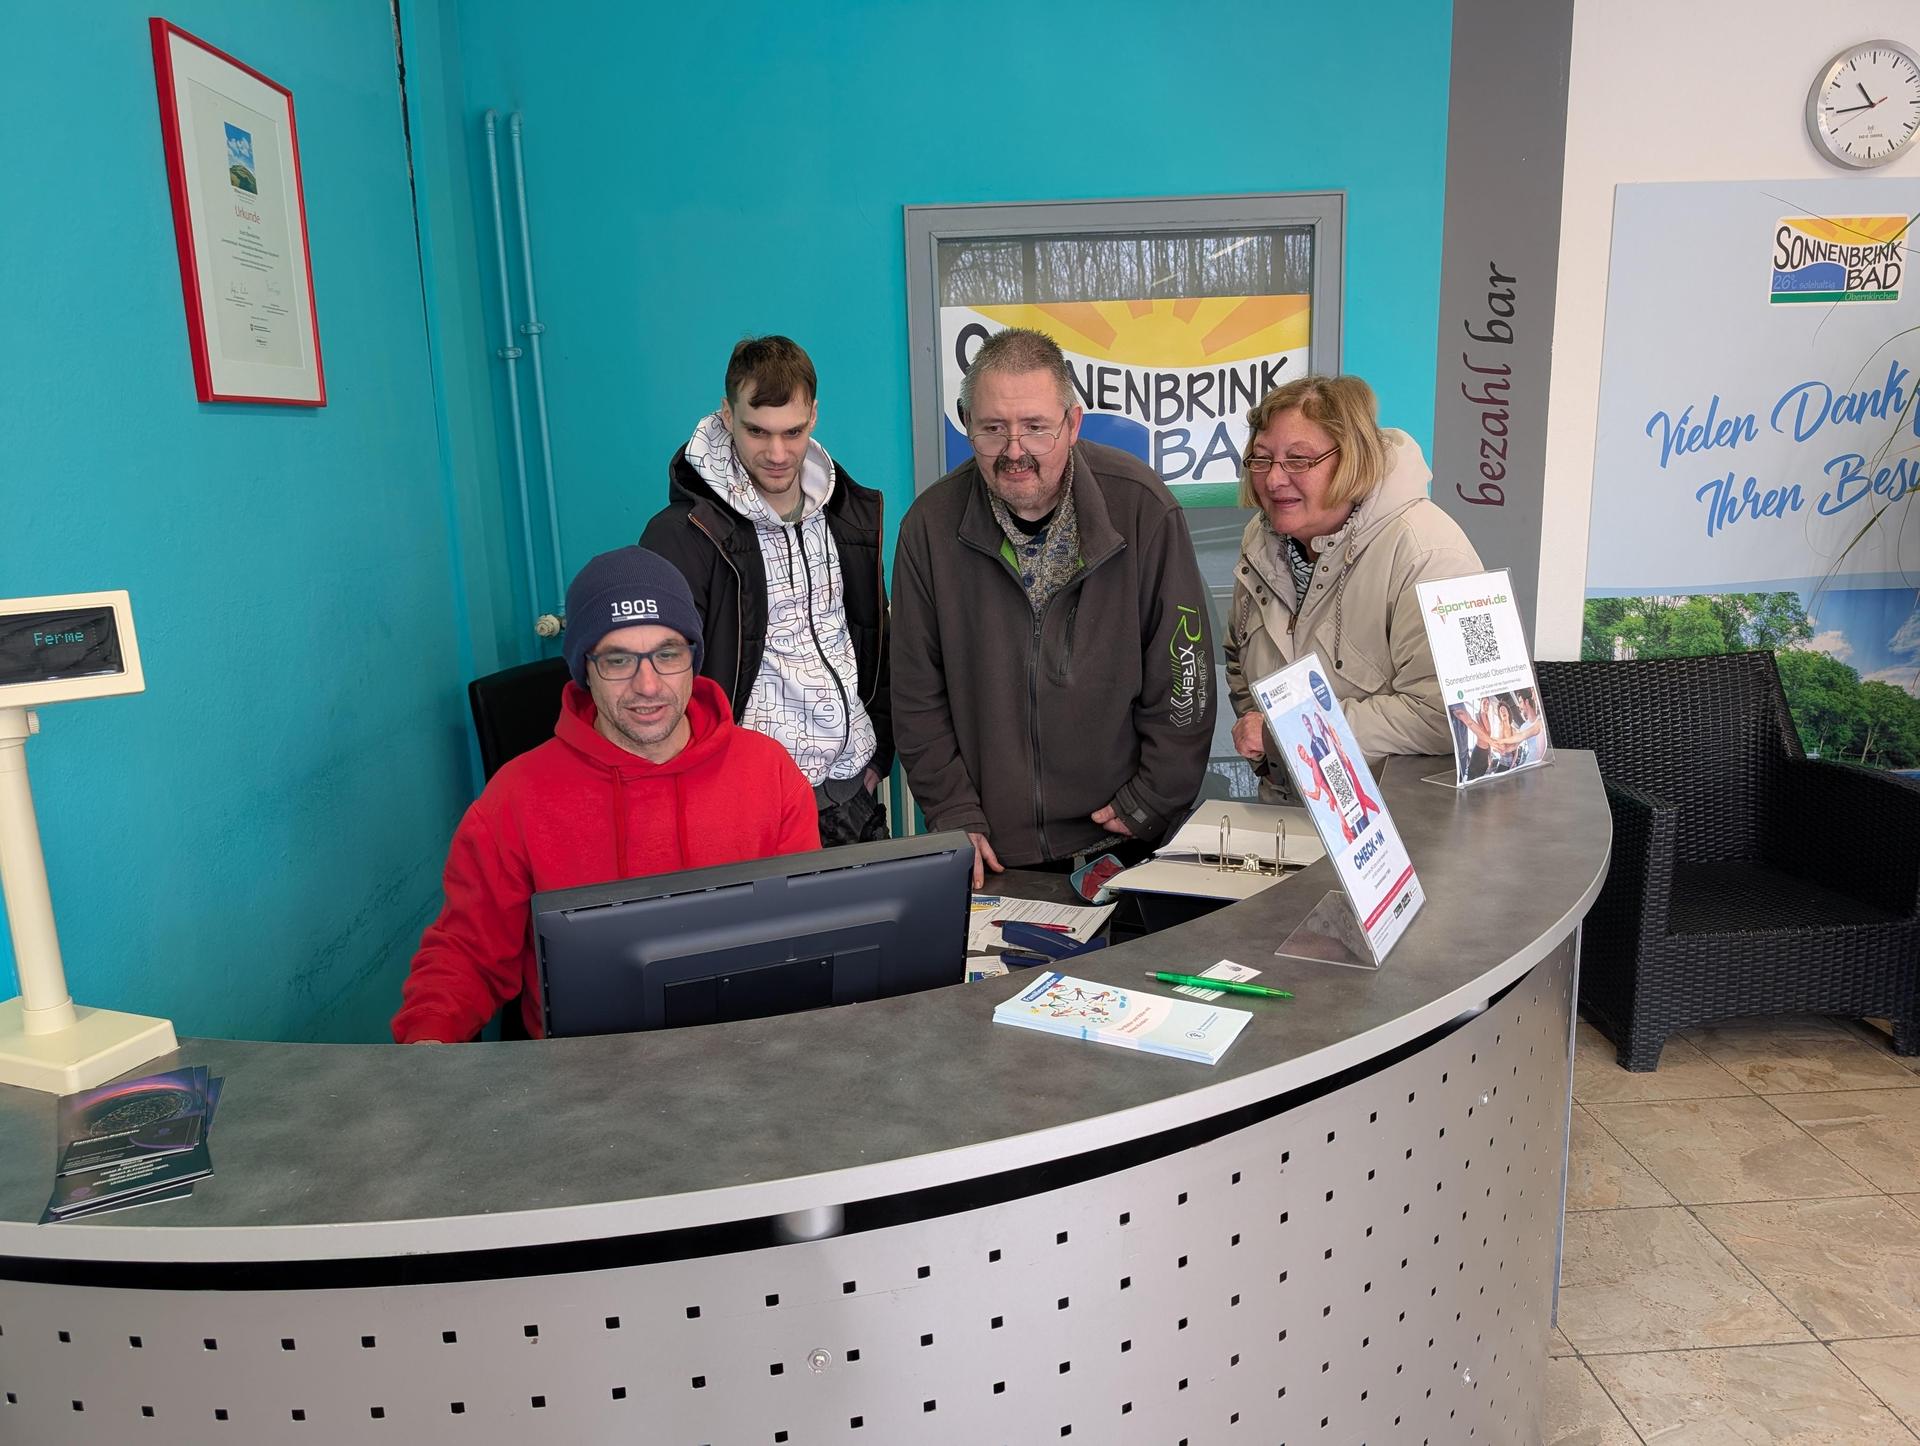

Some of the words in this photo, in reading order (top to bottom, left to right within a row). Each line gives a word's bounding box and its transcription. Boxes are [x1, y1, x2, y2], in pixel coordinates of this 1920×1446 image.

[234, 203, 262, 225] Urkunde
[1774, 225, 1903, 270] SONNENBRINK
[1846, 262, 1902, 291] BAD
[1463, 260, 1518, 345] bar
[1844, 292, 1899, 301] Obernkirchen
[1456, 351, 1513, 508] bezahl
[1645, 394, 1758, 469] Vielen
[1770, 360, 1910, 443] Dank
[1154, 422, 1242, 481] BA
[1695, 472, 1804, 538] Ihren
[611, 599, 658, 616] 1905
[1437, 593, 1507, 616] sportnavi.de
[33, 631, 85, 646] Ferme
[1444, 669, 1490, 687] Sonnenbrinkbad
[1491, 663, 1528, 677] Obernkirchen
[1353, 829, 1386, 871] CHECK-IN
